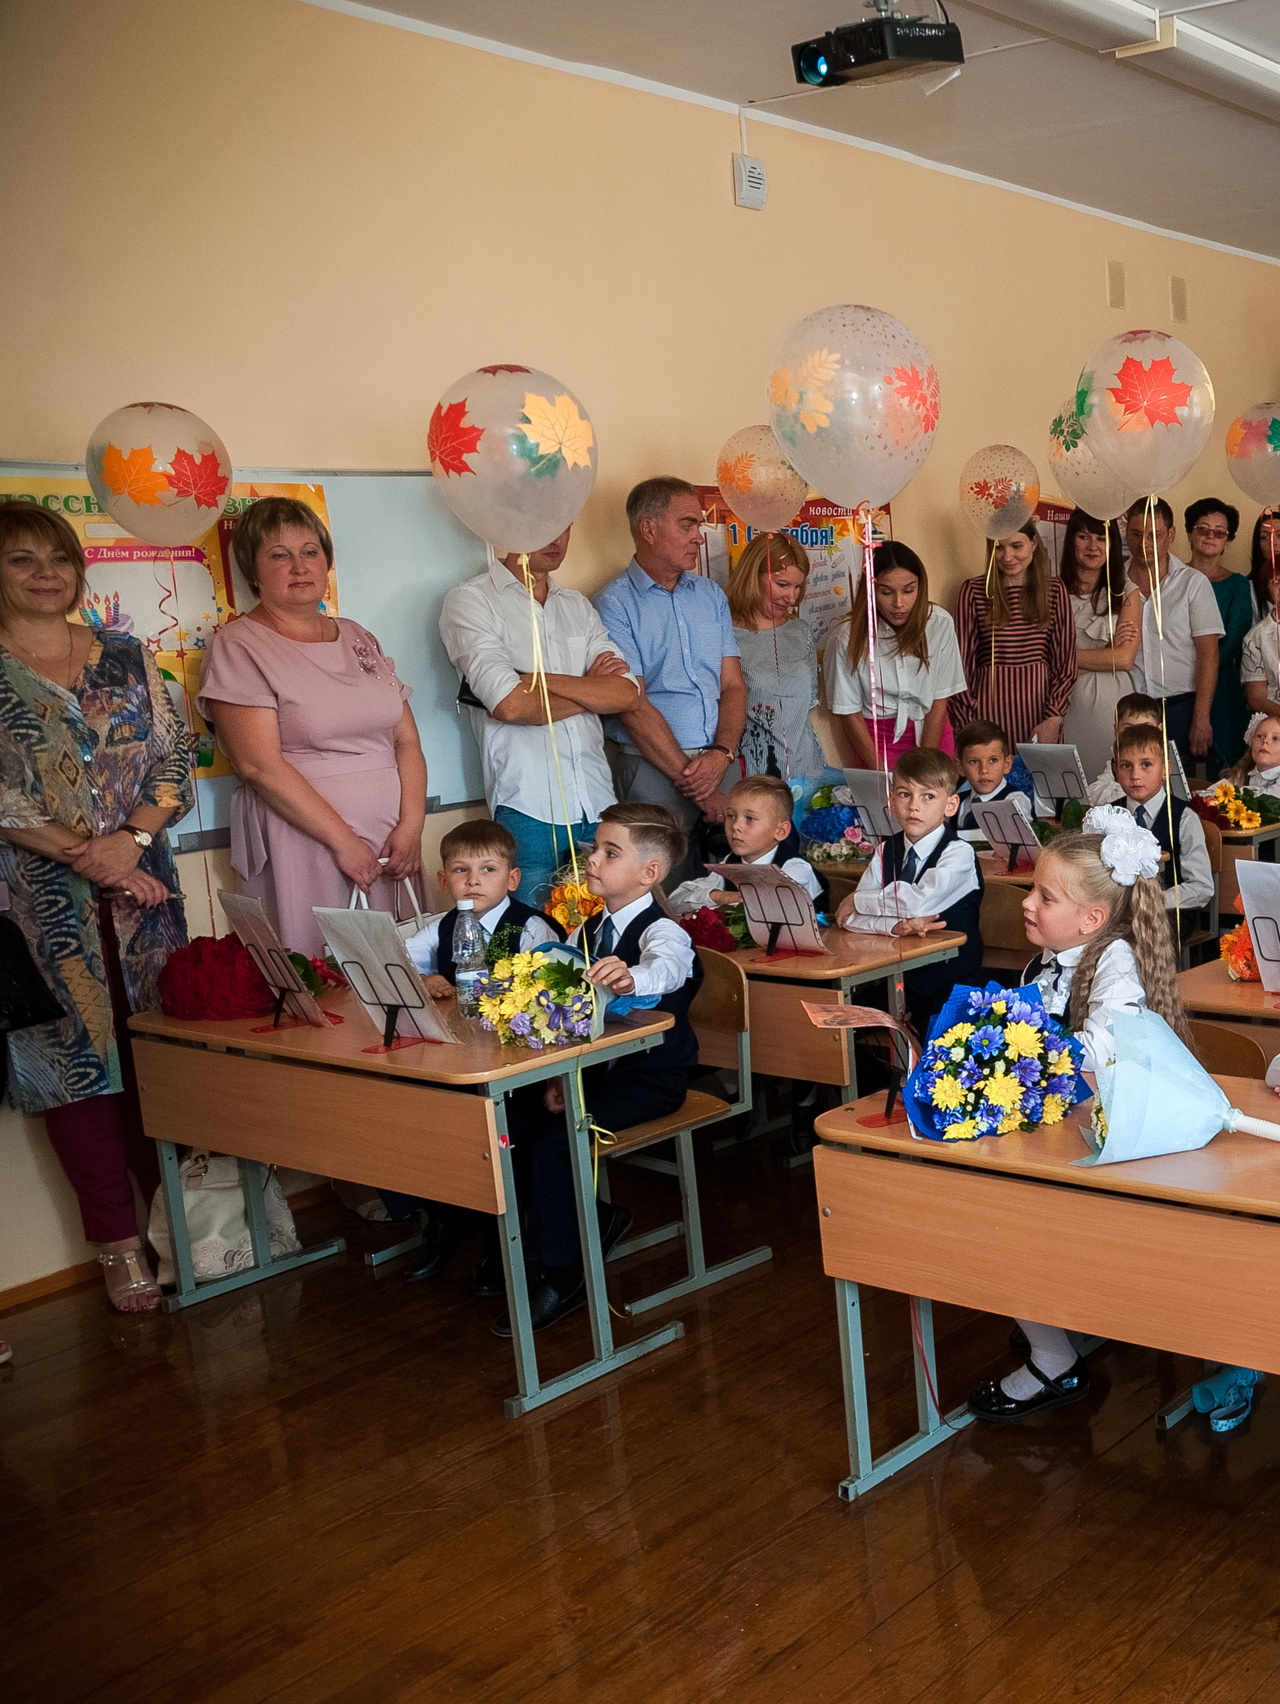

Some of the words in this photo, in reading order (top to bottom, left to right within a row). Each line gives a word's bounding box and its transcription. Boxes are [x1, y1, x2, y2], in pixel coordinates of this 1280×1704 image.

[729, 522, 739, 547] 1
[84, 547, 95, 558] С
[97, 547, 129, 559] Днём
[132, 547, 196, 560] рождния!
